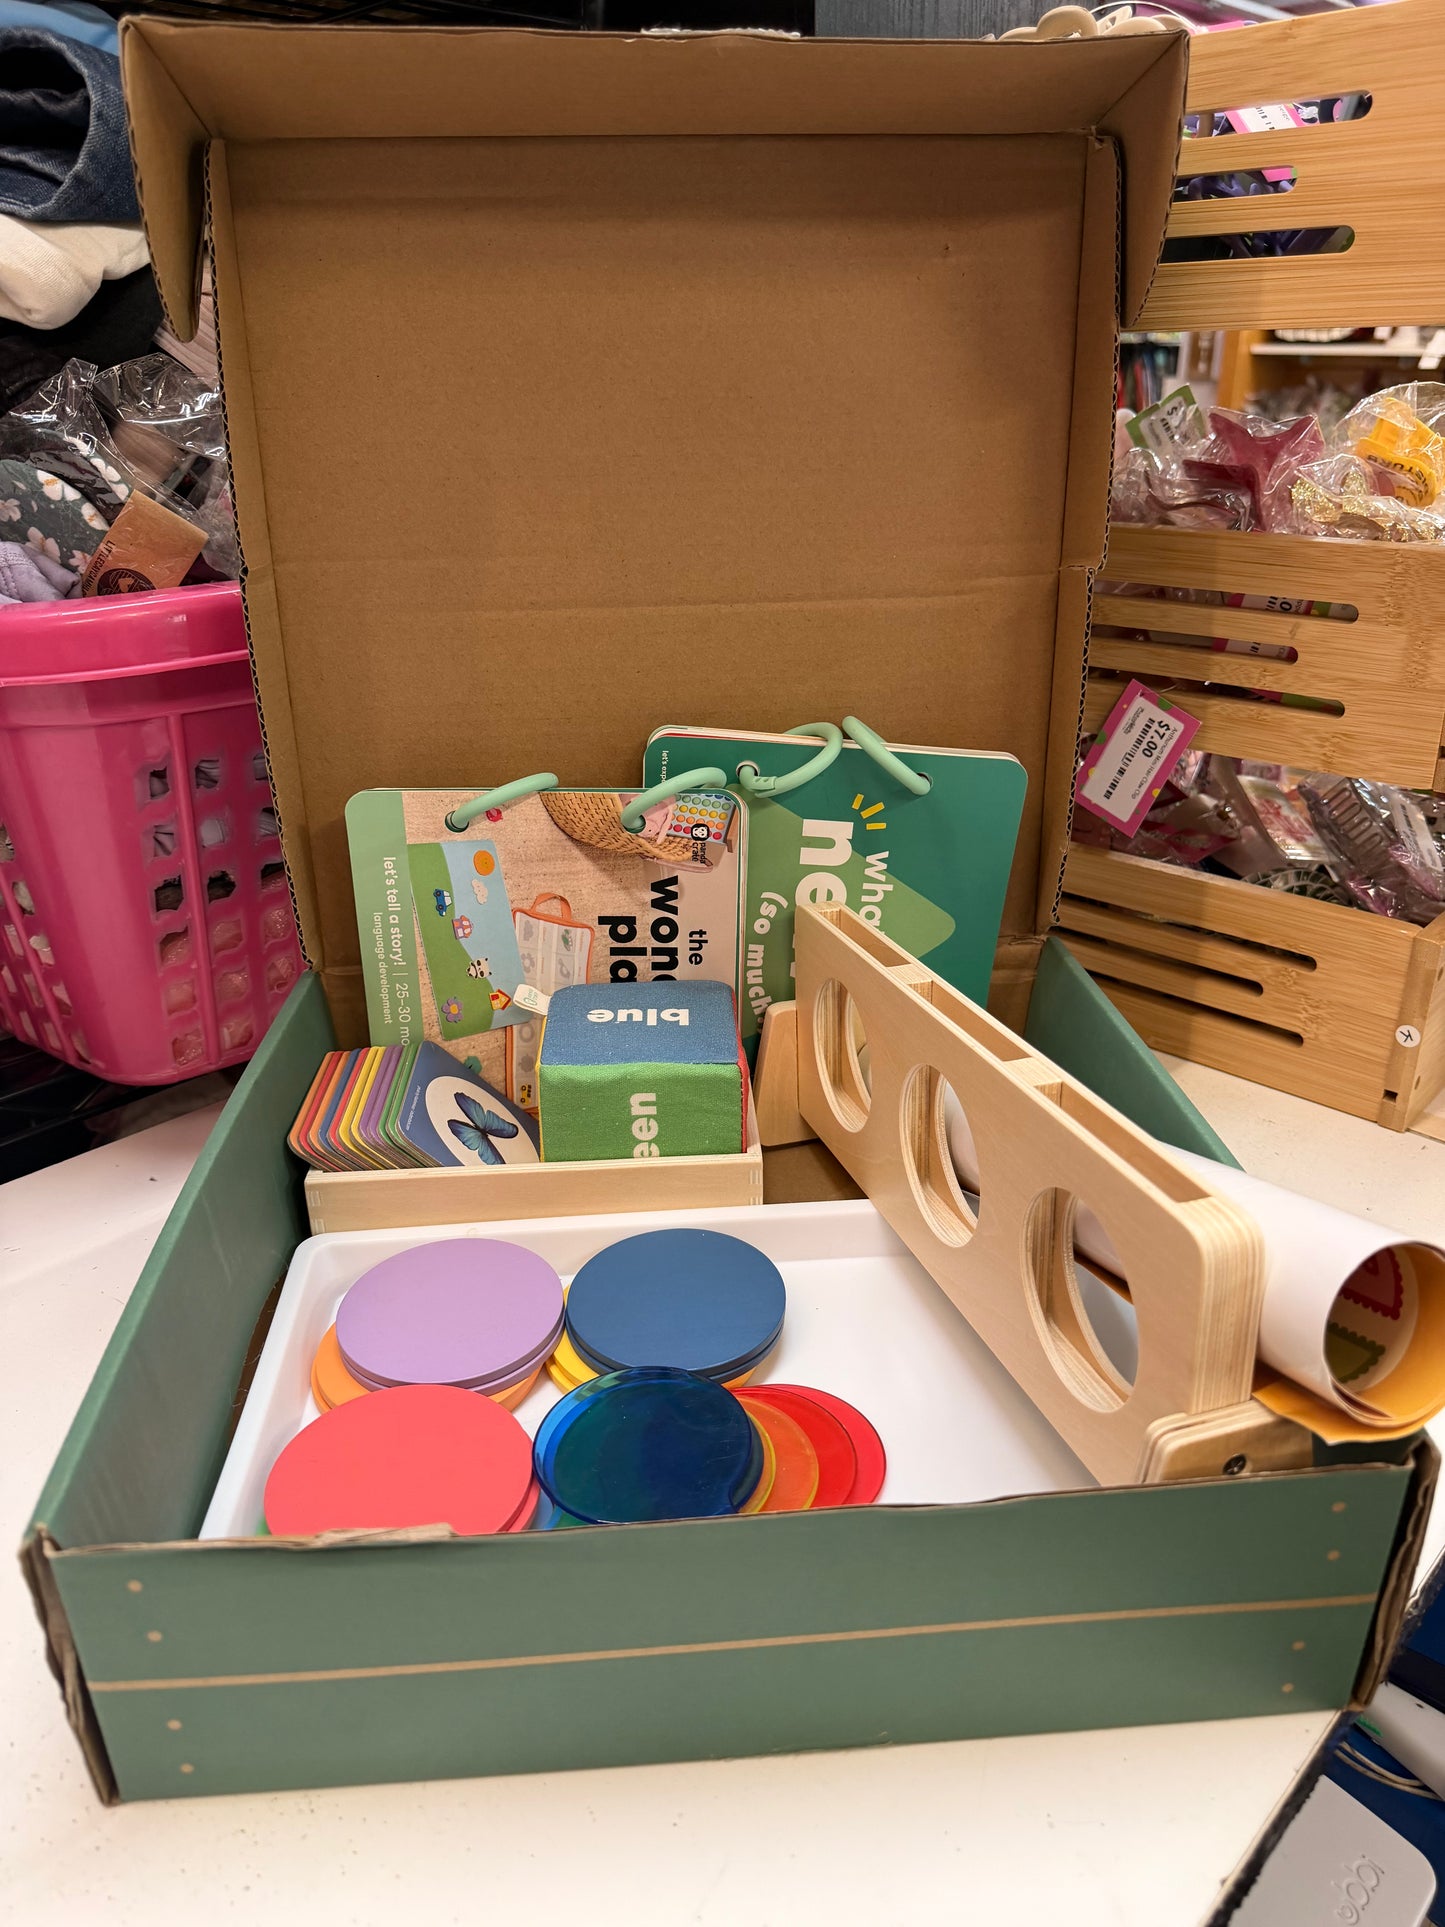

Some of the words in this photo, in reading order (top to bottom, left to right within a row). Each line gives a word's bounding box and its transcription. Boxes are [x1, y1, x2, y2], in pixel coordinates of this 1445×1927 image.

[1141, 720, 1171, 758] $7.00
[383, 857, 397, 886] let's
[691, 843, 699, 862] crate
[386, 889, 401, 911] tell
[857, 851, 894, 935] wha
[389, 915, 399, 924] a
[650, 875, 680, 982] won
[753, 892, 789, 935] (so
[373, 912, 385, 960] language
[389, 926, 407, 966] story!
[688, 929, 708, 966] the
[378, 961, 393, 1025] development
[586, 1008, 690, 1027] blue
